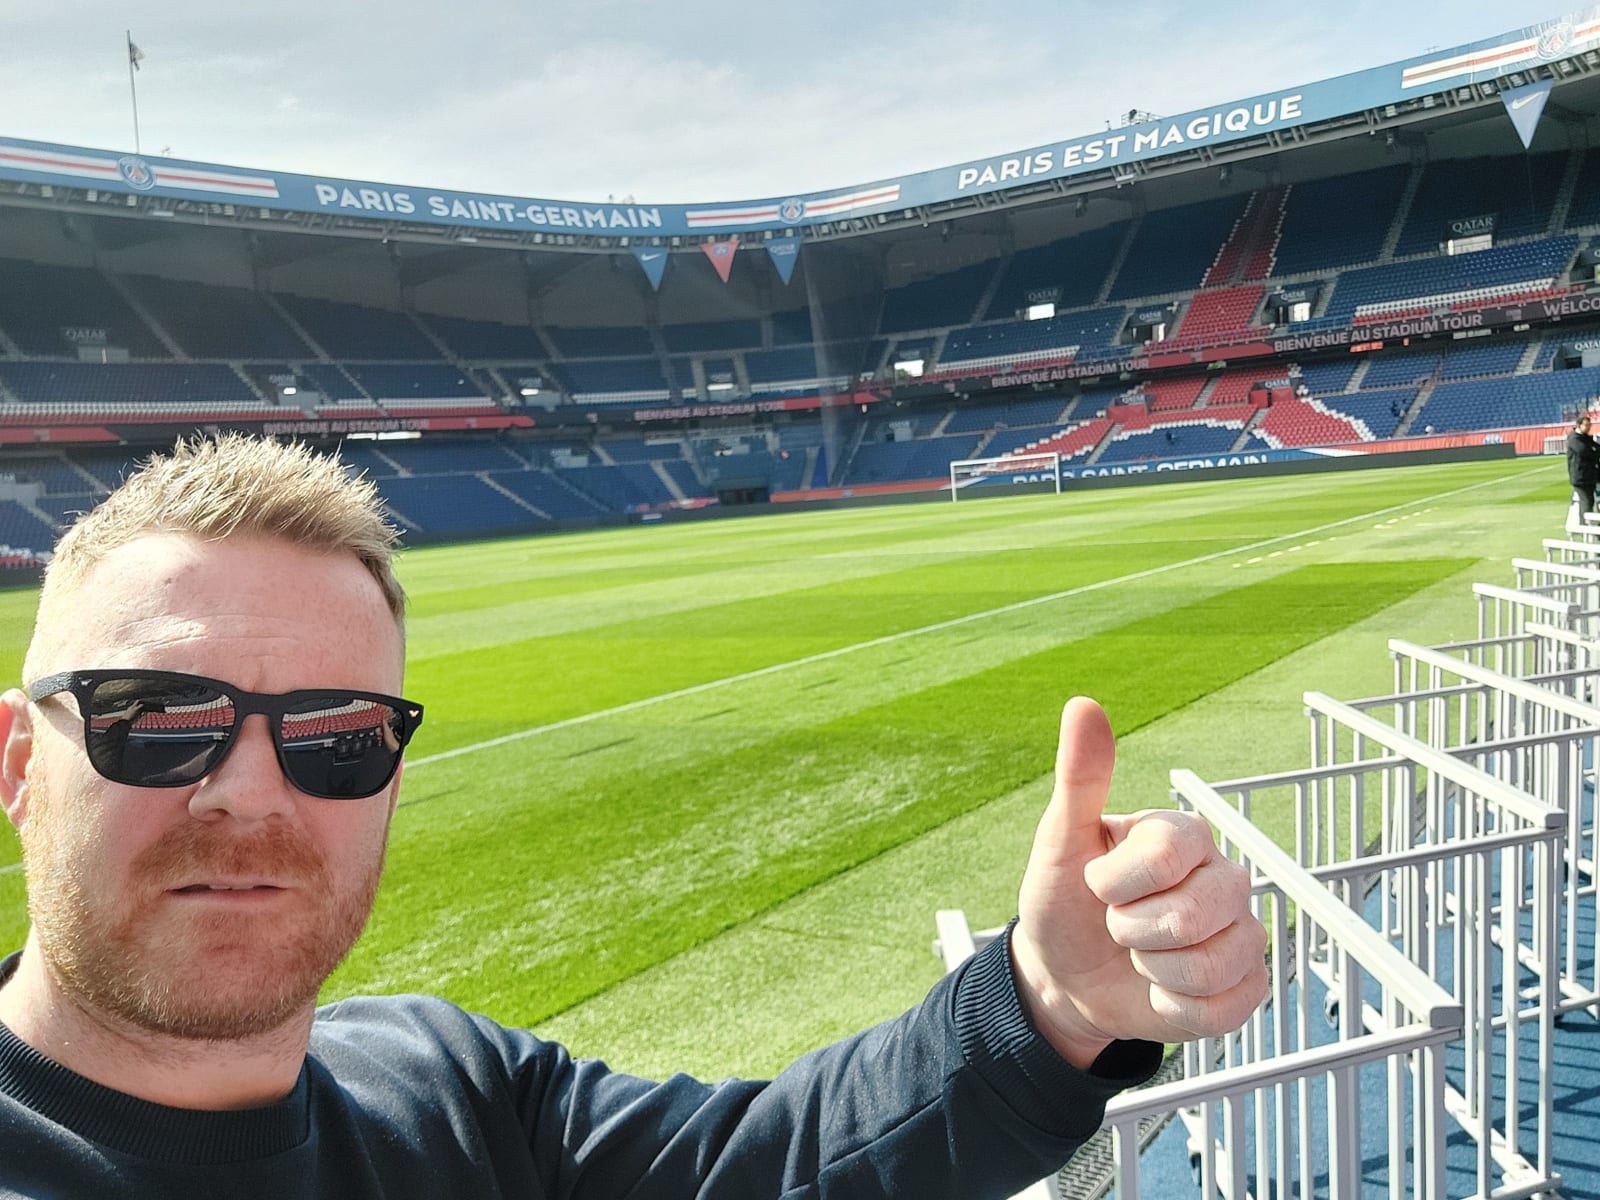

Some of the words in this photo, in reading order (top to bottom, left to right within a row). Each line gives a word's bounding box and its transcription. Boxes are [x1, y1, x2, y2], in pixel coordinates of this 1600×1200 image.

[958, 152, 1053, 190] PARIS
[1063, 135, 1126, 170] EST
[1133, 94, 1303, 153] MAGIQUE
[315, 184, 416, 214] PARIS
[428, 195, 662, 228] SAINT-GERMAIN
[1452, 217, 1493, 233] QATAR
[1274, 331, 1348, 352] BIENVENUE
[1351, 328, 1371, 342] AU
[1372, 320, 1438, 339] STADIUM
[1442, 314, 1483, 330] TOUR
[992, 370, 1049, 388] BIENVENUE
[1050, 369, 1066, 380] AU
[1067, 363, 1117, 379] STADIUM
[1119, 359, 1149, 372] TOUR
